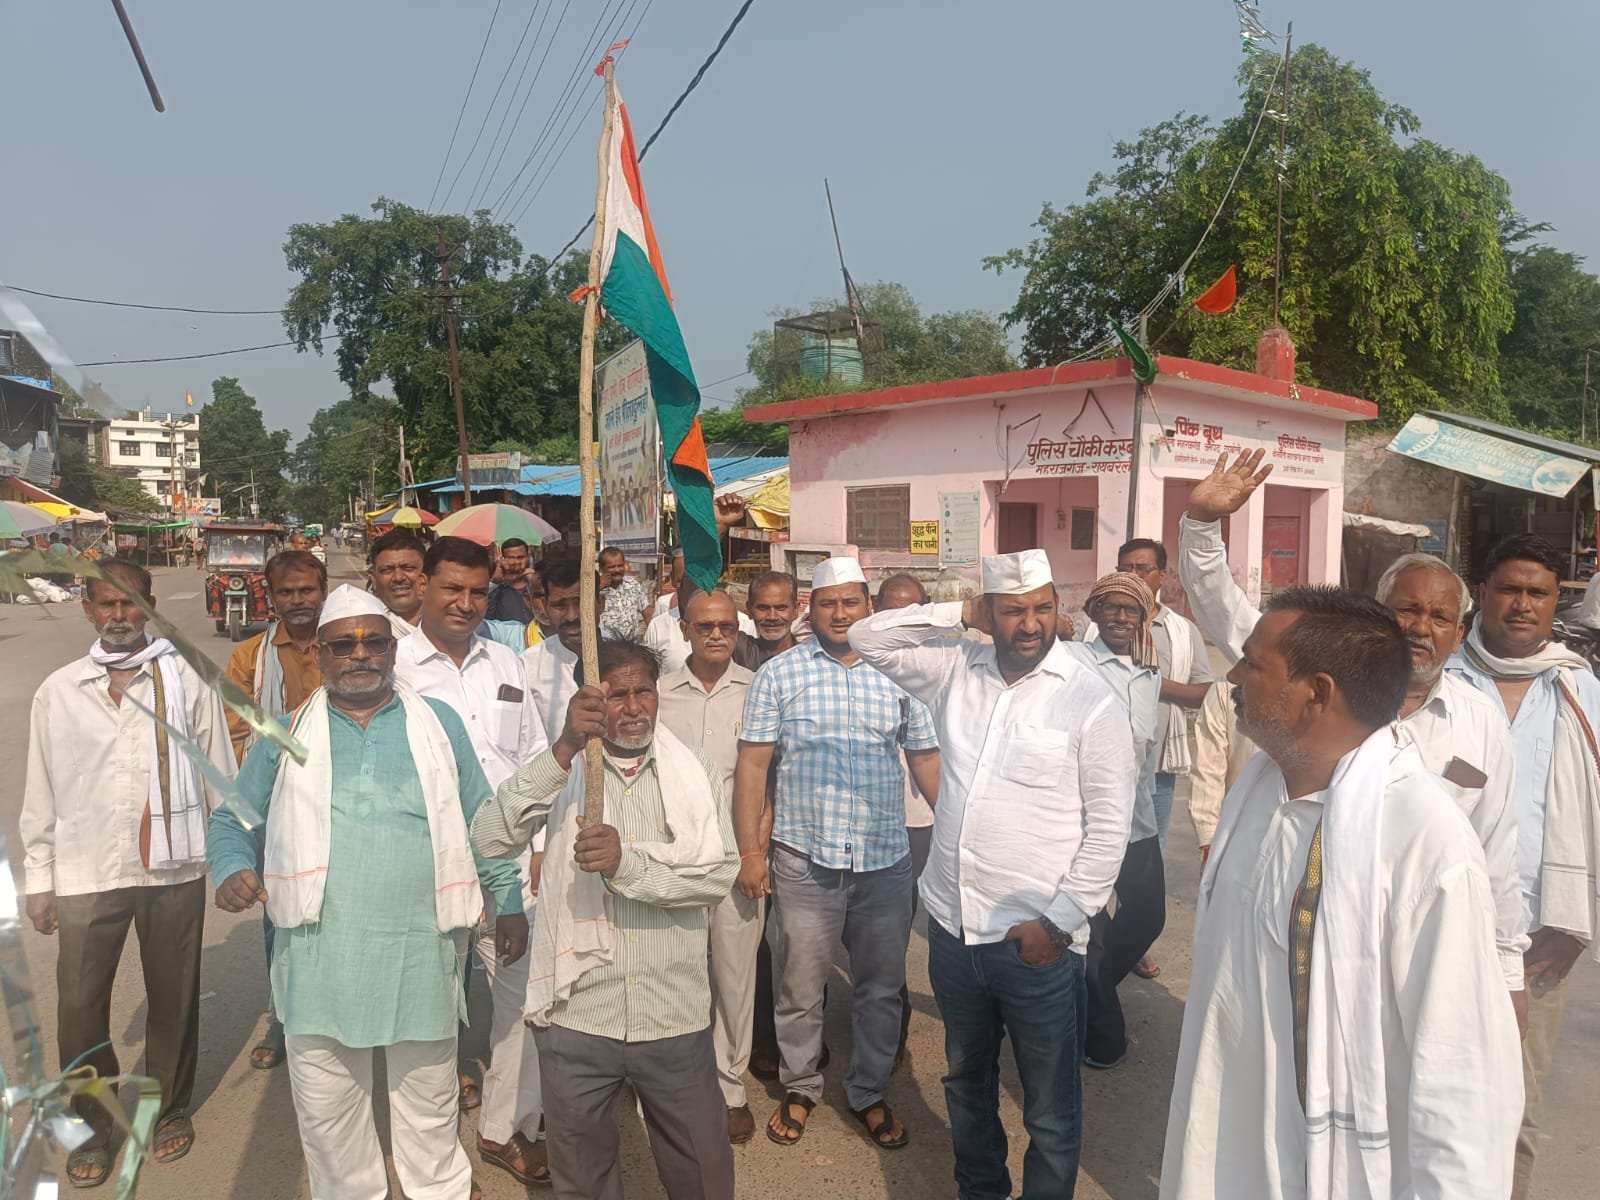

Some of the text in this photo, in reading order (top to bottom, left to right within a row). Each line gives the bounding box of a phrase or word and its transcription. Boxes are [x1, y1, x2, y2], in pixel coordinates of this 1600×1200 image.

[1174, 416, 1223, 444] पिंक बूथ
[1026, 437, 1068, 465] पुलिस
[1069, 434, 1104, 458] चौकी
